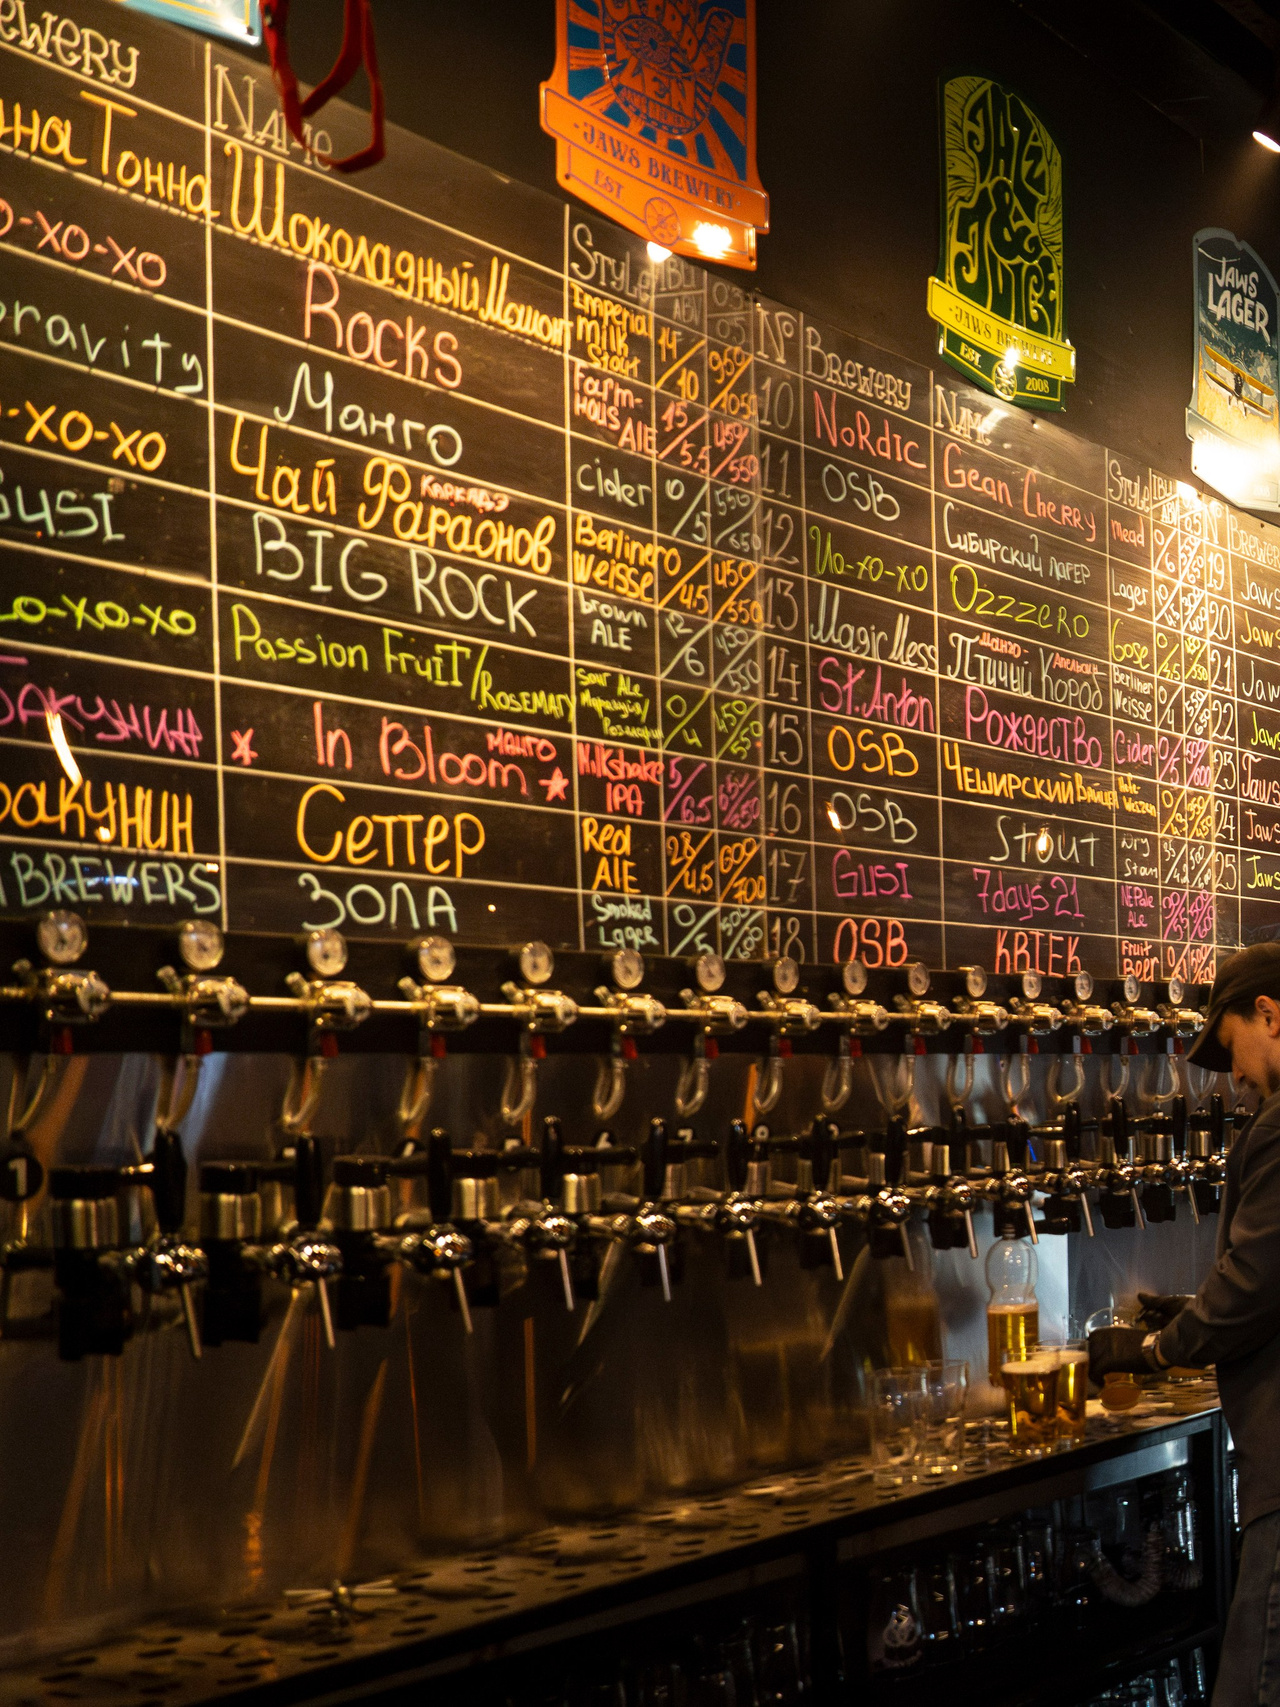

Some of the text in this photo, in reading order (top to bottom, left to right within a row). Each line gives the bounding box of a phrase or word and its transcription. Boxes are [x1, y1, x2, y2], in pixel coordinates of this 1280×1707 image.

[582, 120, 641, 170] JAWS
[304, 262, 463, 389] Rocks
[954, 305, 992, 340] JAWS
[1207, 272, 1271, 347] LAGER
[760, 377, 795, 431] 10
[1025, 375, 1050, 394] 2008
[274, 362, 463, 467] Манго
[231, 413, 337, 515] Чай
[576, 458, 651, 507] Cider
[761, 444, 791, 499] 11
[821, 463, 900, 522] OSB
[761, 508, 800, 565] 12
[252, 510, 538, 637] BIG ROCK
[1111, 568, 1149, 612] Lager
[1207, 552, 1225, 591] 19
[761, 577, 799, 632] 13
[1208, 601, 1231, 641] 20
[232, 604, 368, 672] Passion
[591, 619, 632, 651] ALE
[766, 645, 801, 703] 14
[1210, 650, 1233, 692] 21
[768, 711, 803, 765] 15
[1211, 699, 1236, 741] 22
[313, 702, 530, 797] In Bloom
[827, 725, 919, 777] OSB
[1114, 729, 1156, 766] Cider
[1213, 749, 1237, 792] 23
[606, 782, 644, 816] IPA
[768, 781, 804, 835] 16
[1214, 800, 1236, 842] 24
[297, 783, 486, 878] Сеттер
[582, 816, 632, 857] Red
[768, 849, 808, 902] 17
[1216, 851, 1237, 891] 25
[769, 915, 805, 966] 18
[833, 917, 908, 967] OSB
